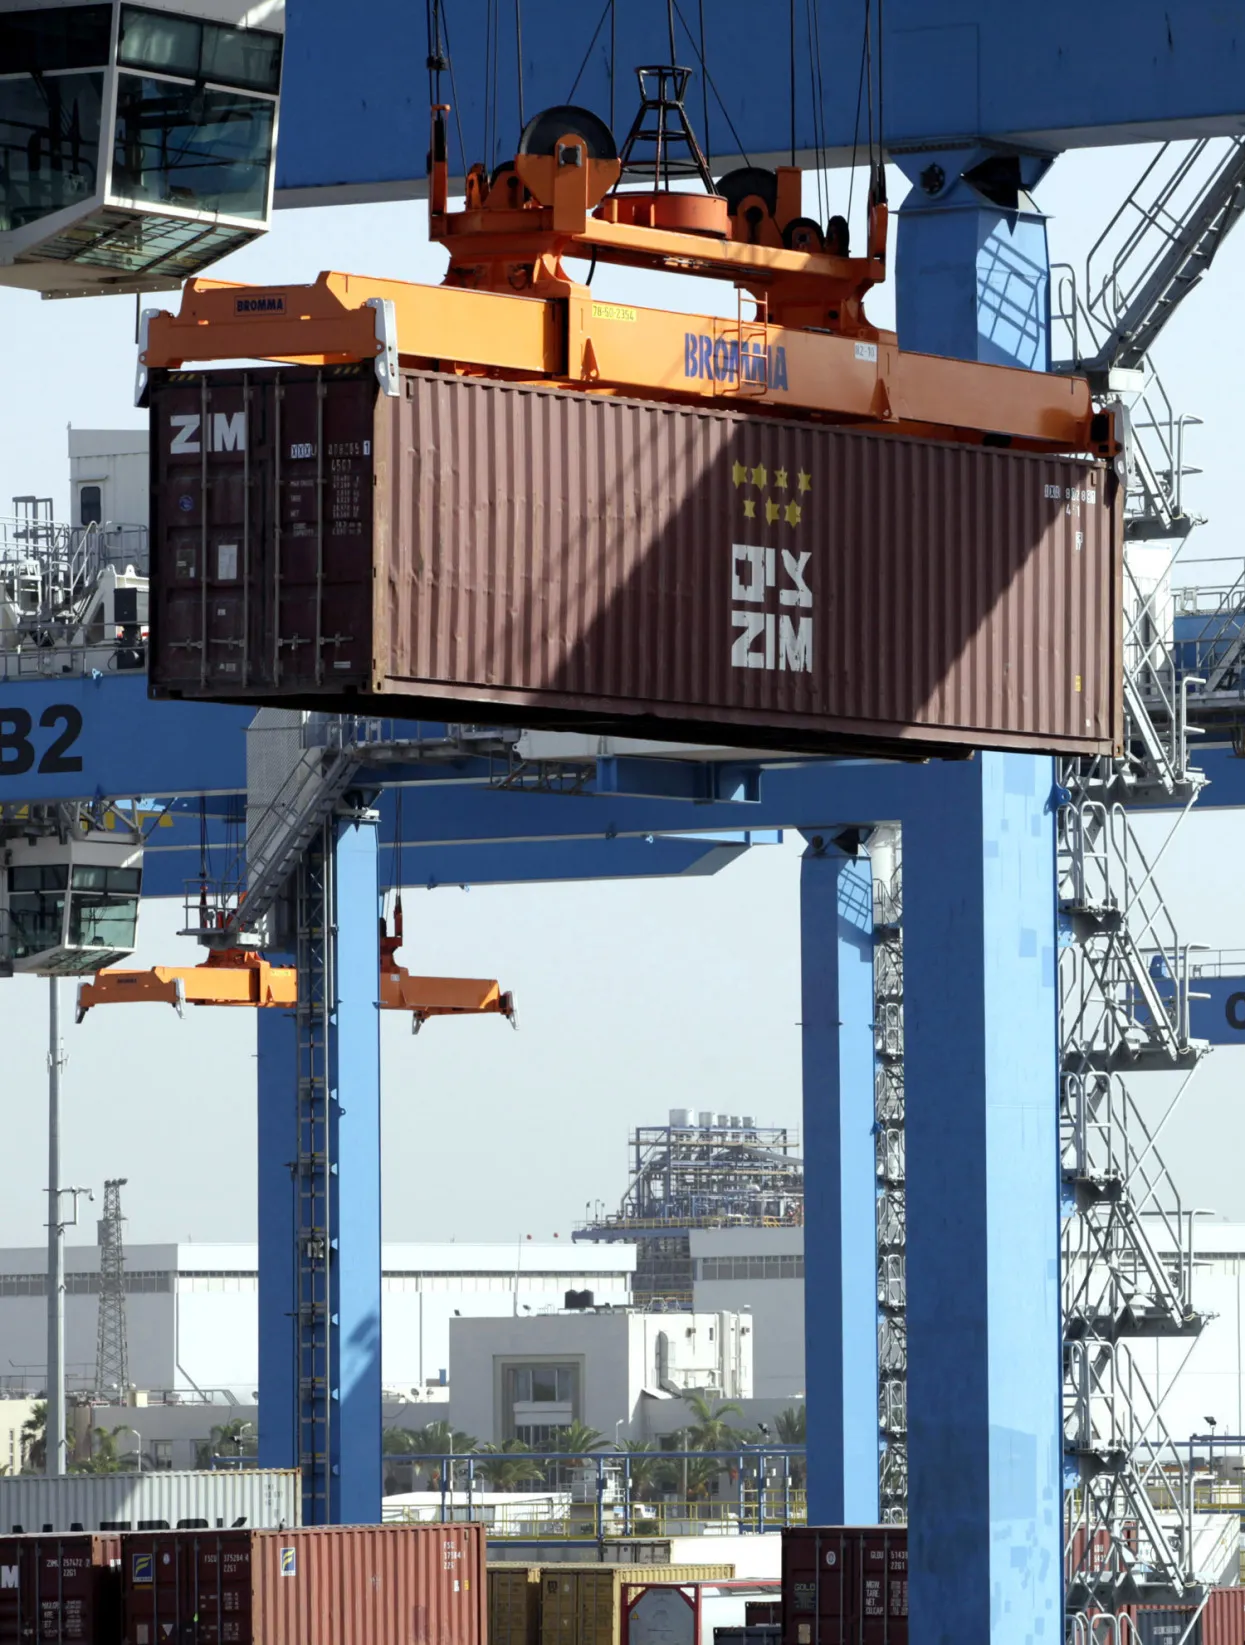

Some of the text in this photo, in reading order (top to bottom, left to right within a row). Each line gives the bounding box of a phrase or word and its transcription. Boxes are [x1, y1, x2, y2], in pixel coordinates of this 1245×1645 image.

[170, 412, 246, 454] ZIM
[732, 543, 813, 608] צים
[731, 610, 813, 673] ZIM
